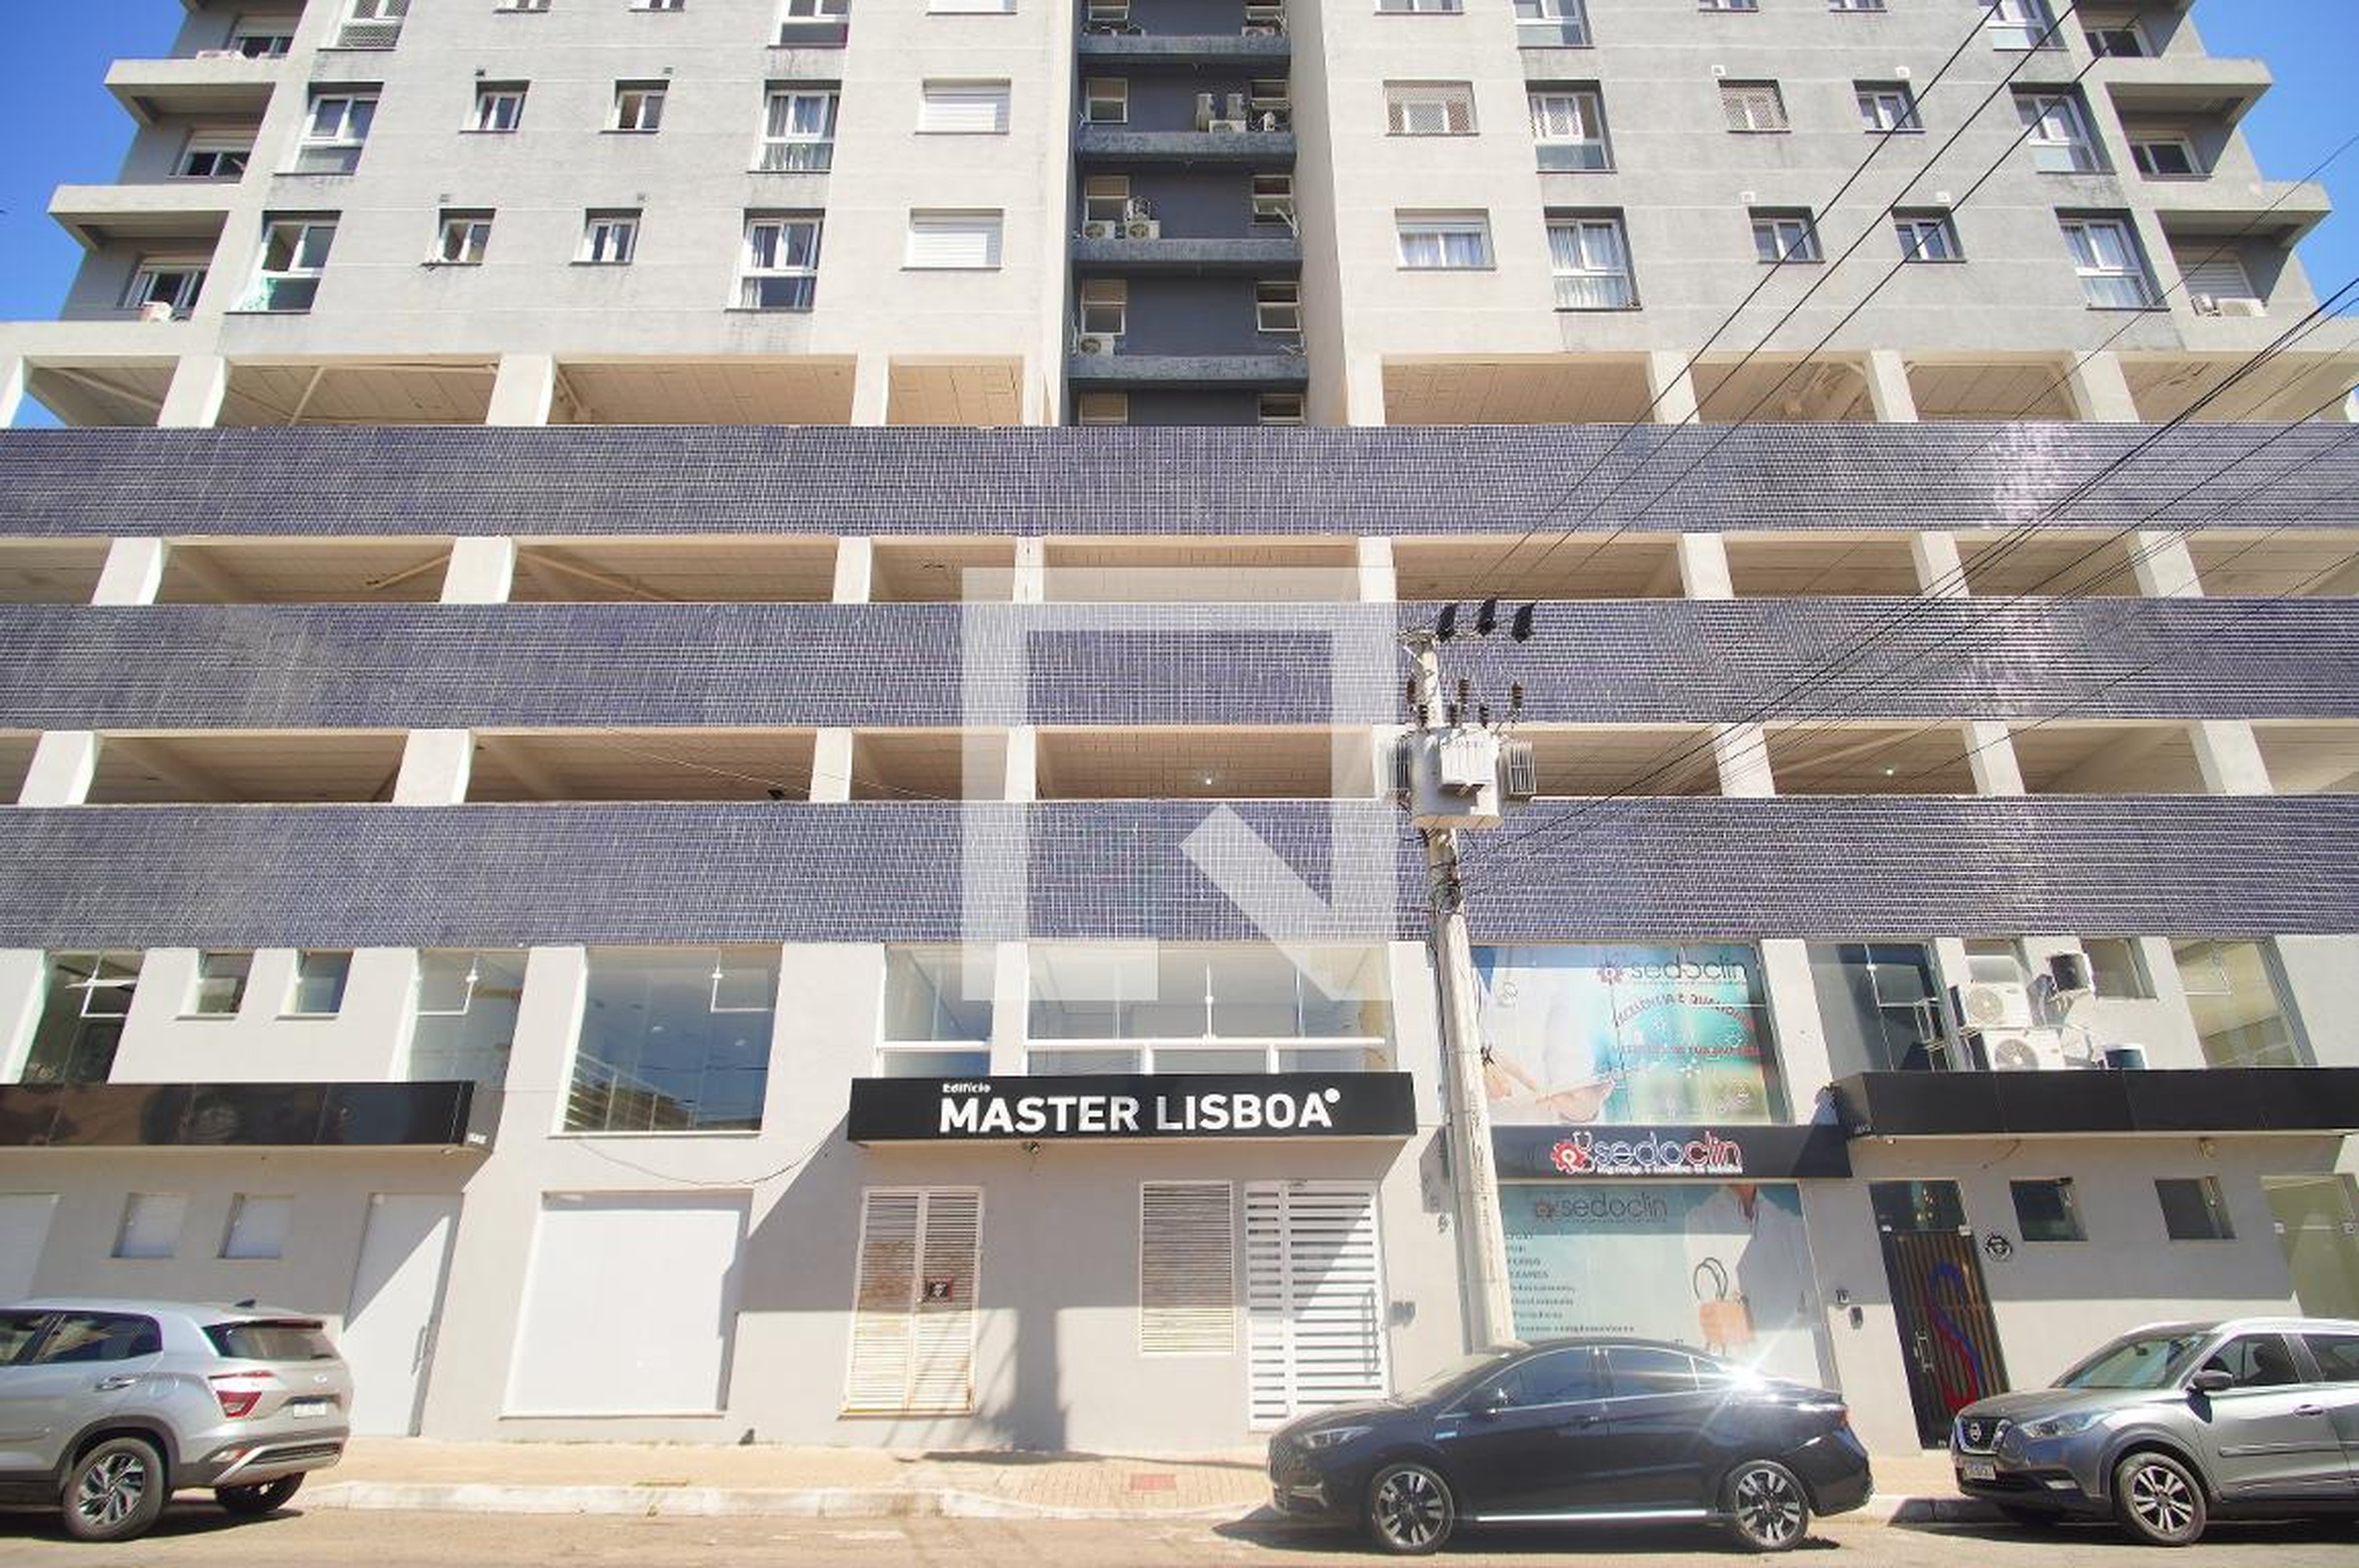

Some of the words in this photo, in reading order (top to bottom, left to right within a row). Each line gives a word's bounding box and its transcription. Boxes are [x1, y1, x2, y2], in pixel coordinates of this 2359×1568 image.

[940, 1096, 1140, 1133] MASTER
[1156, 1093, 1333, 1130] LISBOA
[1595, 1131, 1742, 1166] sedoclin
[1562, 1192, 1667, 1217] sedoclin
